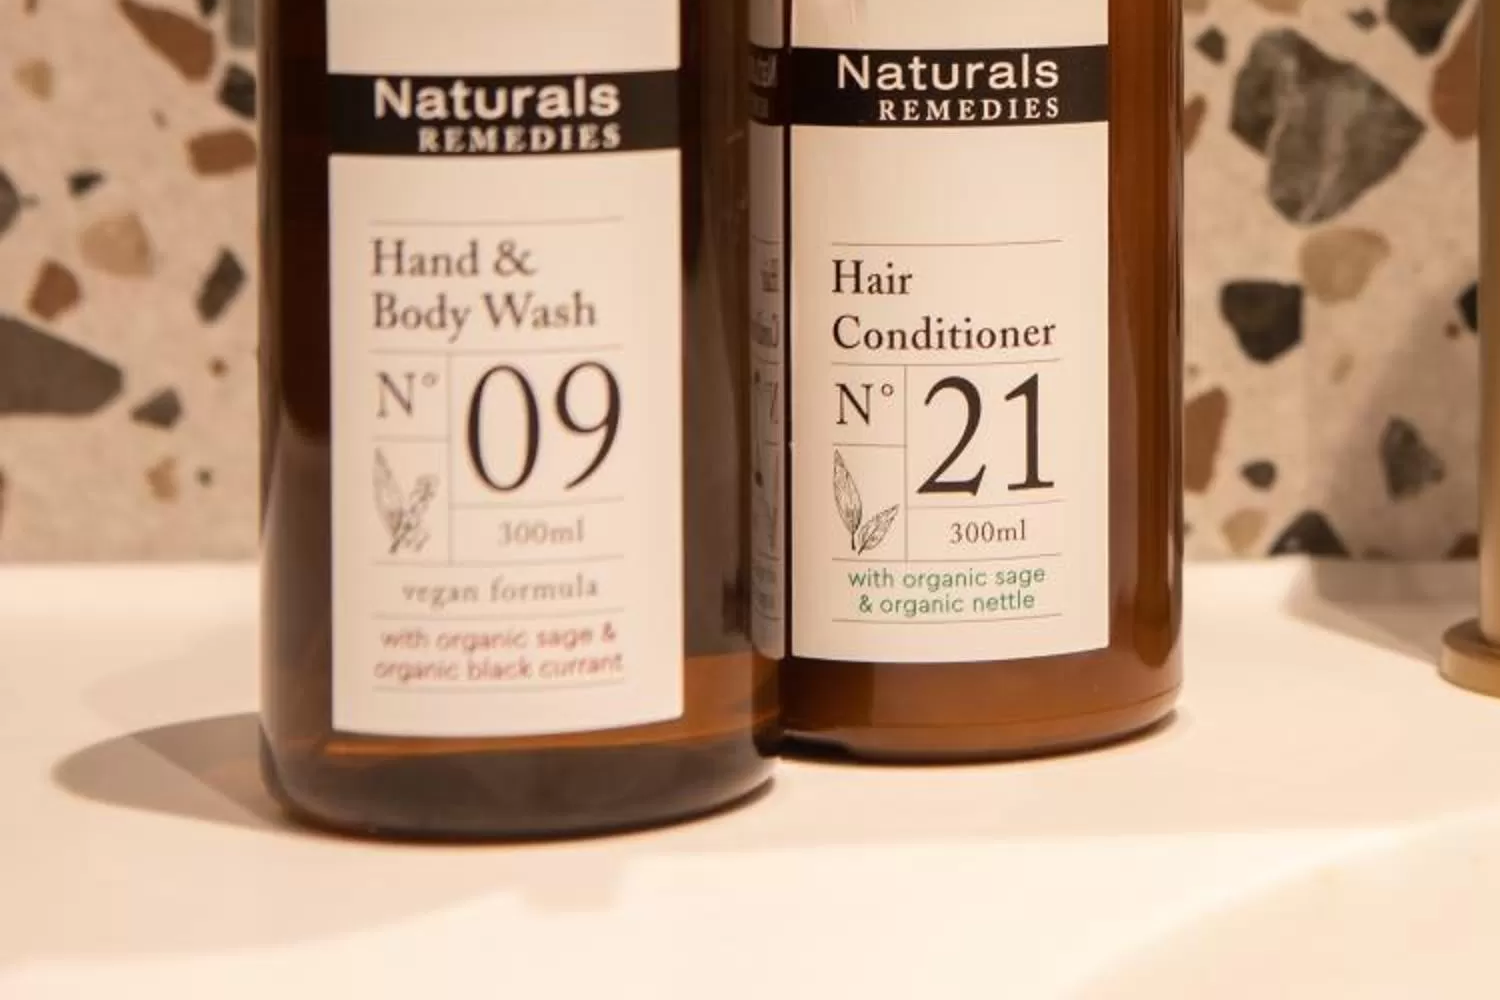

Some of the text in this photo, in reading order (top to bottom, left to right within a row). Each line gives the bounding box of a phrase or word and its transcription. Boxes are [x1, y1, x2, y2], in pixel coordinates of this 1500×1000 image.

[837, 53, 1059, 91] Naturals
[373, 75, 620, 120] Naturals
[879, 97, 1059, 122] REMEDIES
[418, 123, 621, 153] REMEDIES
[370, 237, 537, 278] Hand &
[831, 259, 913, 295] Hair
[371, 290, 597, 343] Body Wash
[832, 314, 1056, 350] Conditioner
[467, 361, 621, 493] 09
[917, 372, 1054, 497] 21
[498, 516, 585, 546] 300ml
[949, 519, 1026, 544] 300ml
[402, 573, 599, 607] vegan formula
[847, 564, 1045, 592] with organic sage
[858, 590, 1035, 618] & organic nettle
[380, 621, 617, 652] with organic sage &
[373, 654, 623, 685] organic black currant
